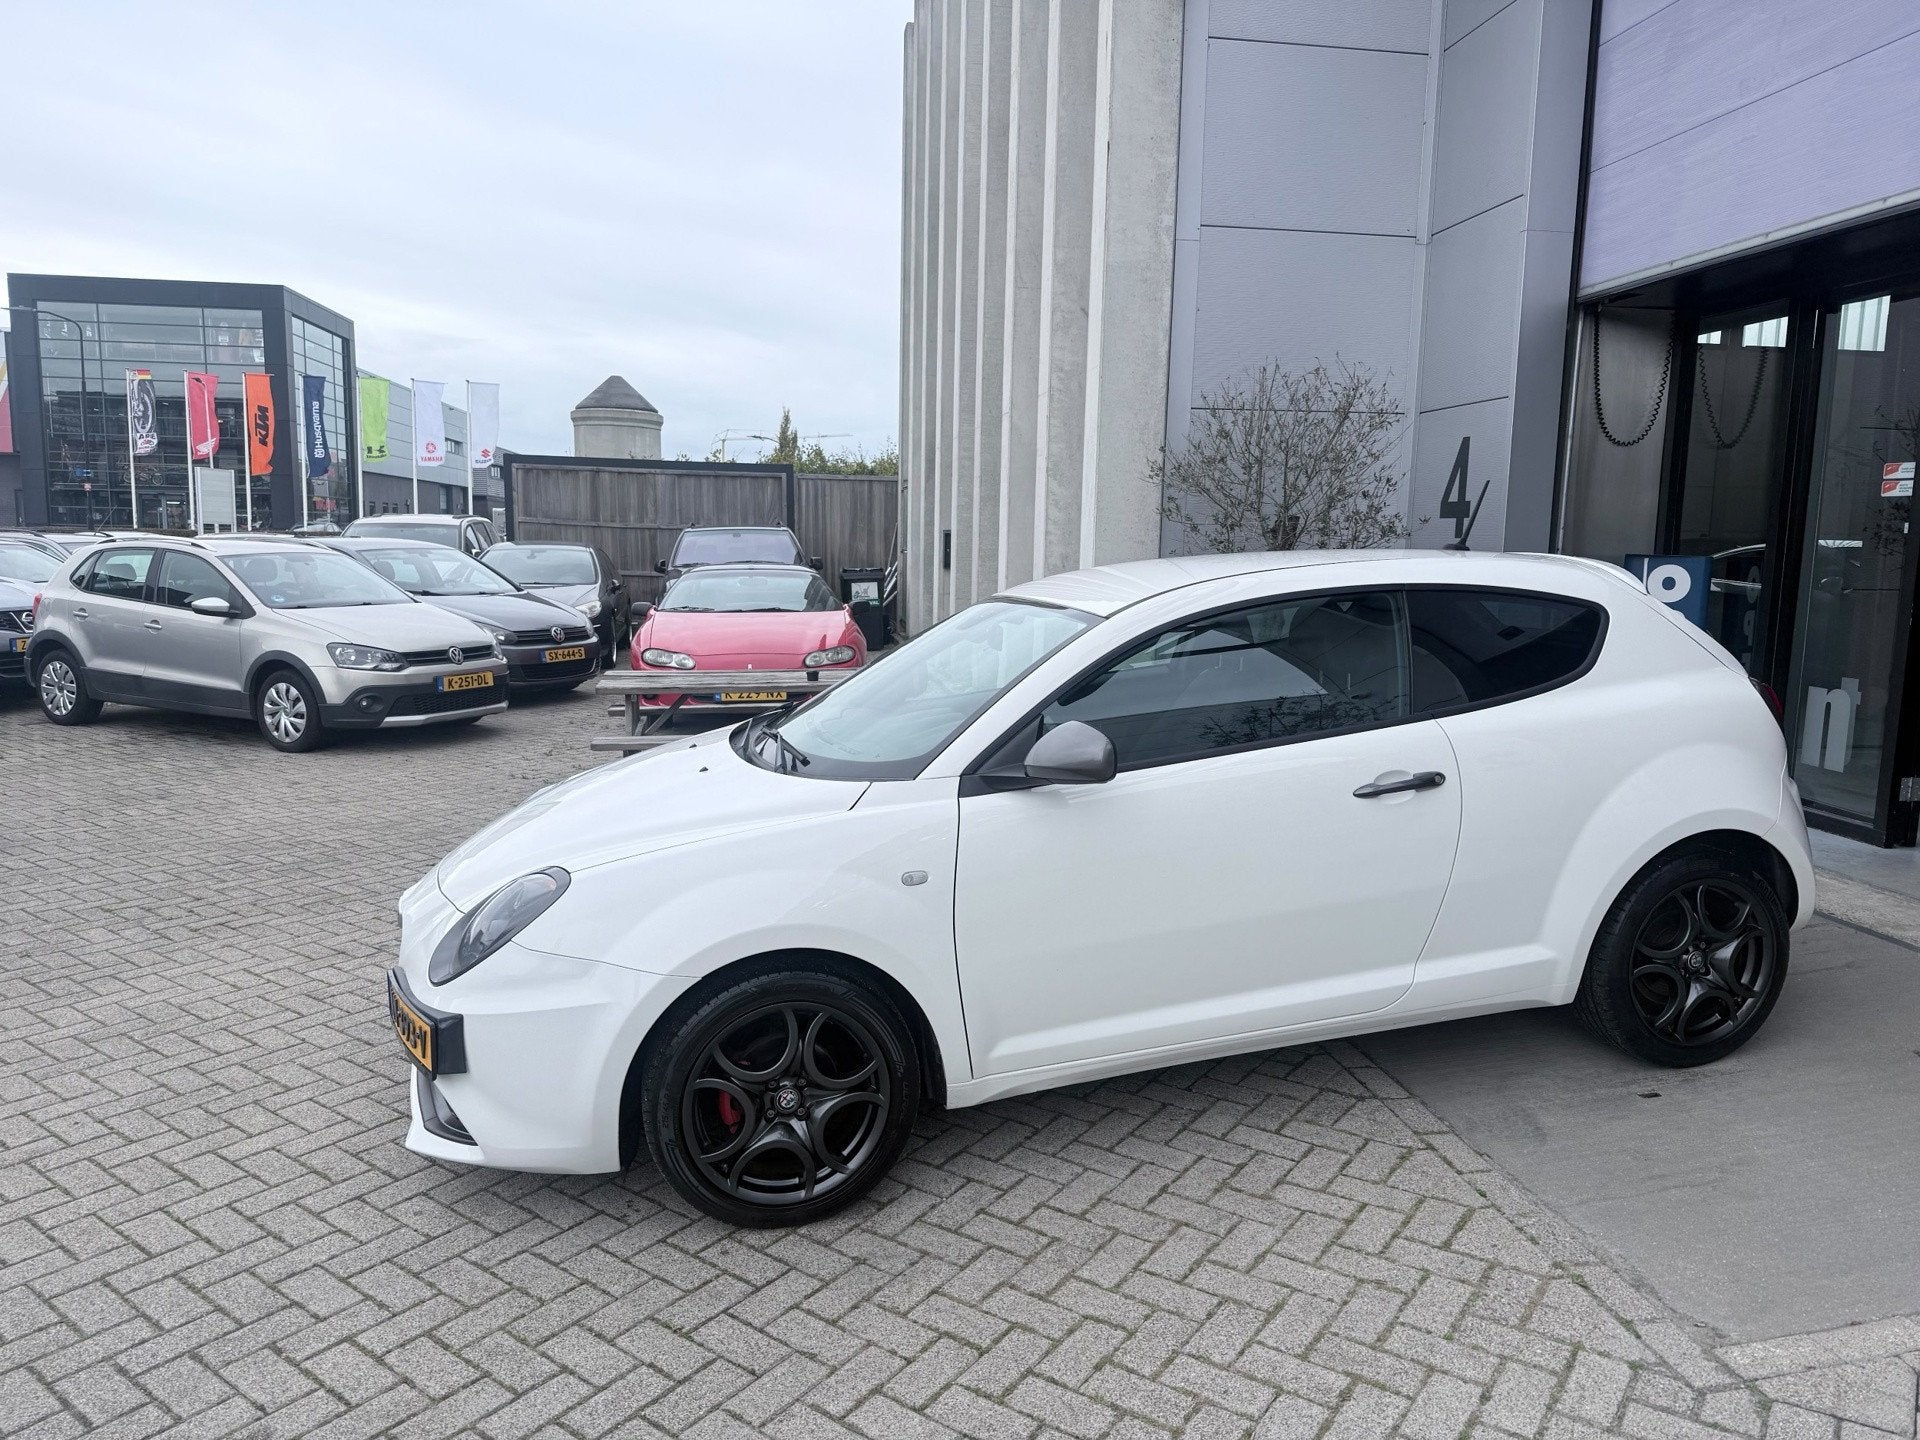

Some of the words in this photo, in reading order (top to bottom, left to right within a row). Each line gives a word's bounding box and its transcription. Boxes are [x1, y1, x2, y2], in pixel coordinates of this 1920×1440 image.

[255, 404, 270, 447] KTM
[312, 401, 324, 448] Husqvarna
[1439, 435, 1471, 539] 4
[548, 648, 583, 661] SX-644-S
[447, 674, 489, 689] K-251-DL
